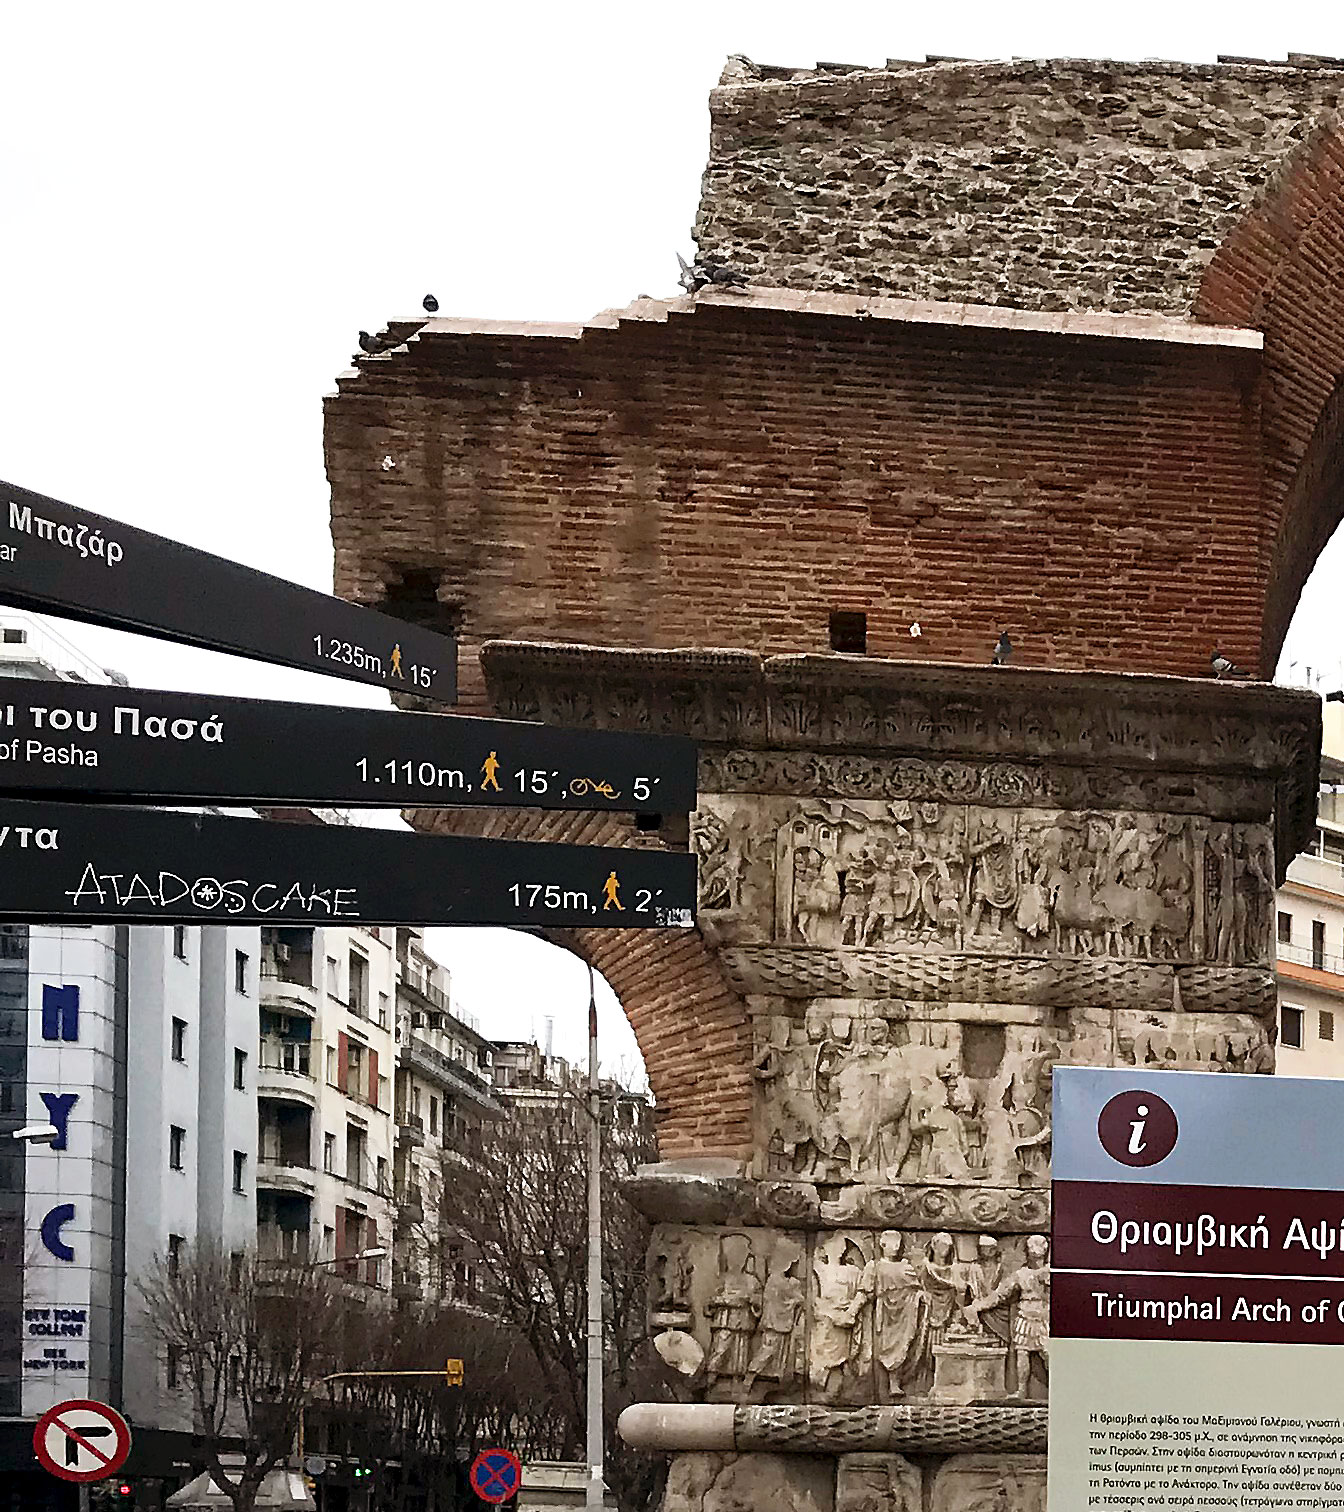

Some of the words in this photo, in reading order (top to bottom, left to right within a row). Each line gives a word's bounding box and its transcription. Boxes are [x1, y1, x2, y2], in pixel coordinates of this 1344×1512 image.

[9, 502, 124, 567] Μπαζάρ
[313, 634, 387, 680] 1.235m,
[29, 706, 98, 732] του
[113, 705, 224, 743] Πασά
[26, 739, 99, 767] Pasha
[355, 757, 473, 793] 1.110m,
[507, 883, 597, 915] 175m,
[1090, 1209, 1270, 1256] Θριαμβική
[1091, 1292, 1222, 1328] Triumphal
[1230, 1296, 1292, 1324] Arch
[1300, 1297, 1329, 1325] of
